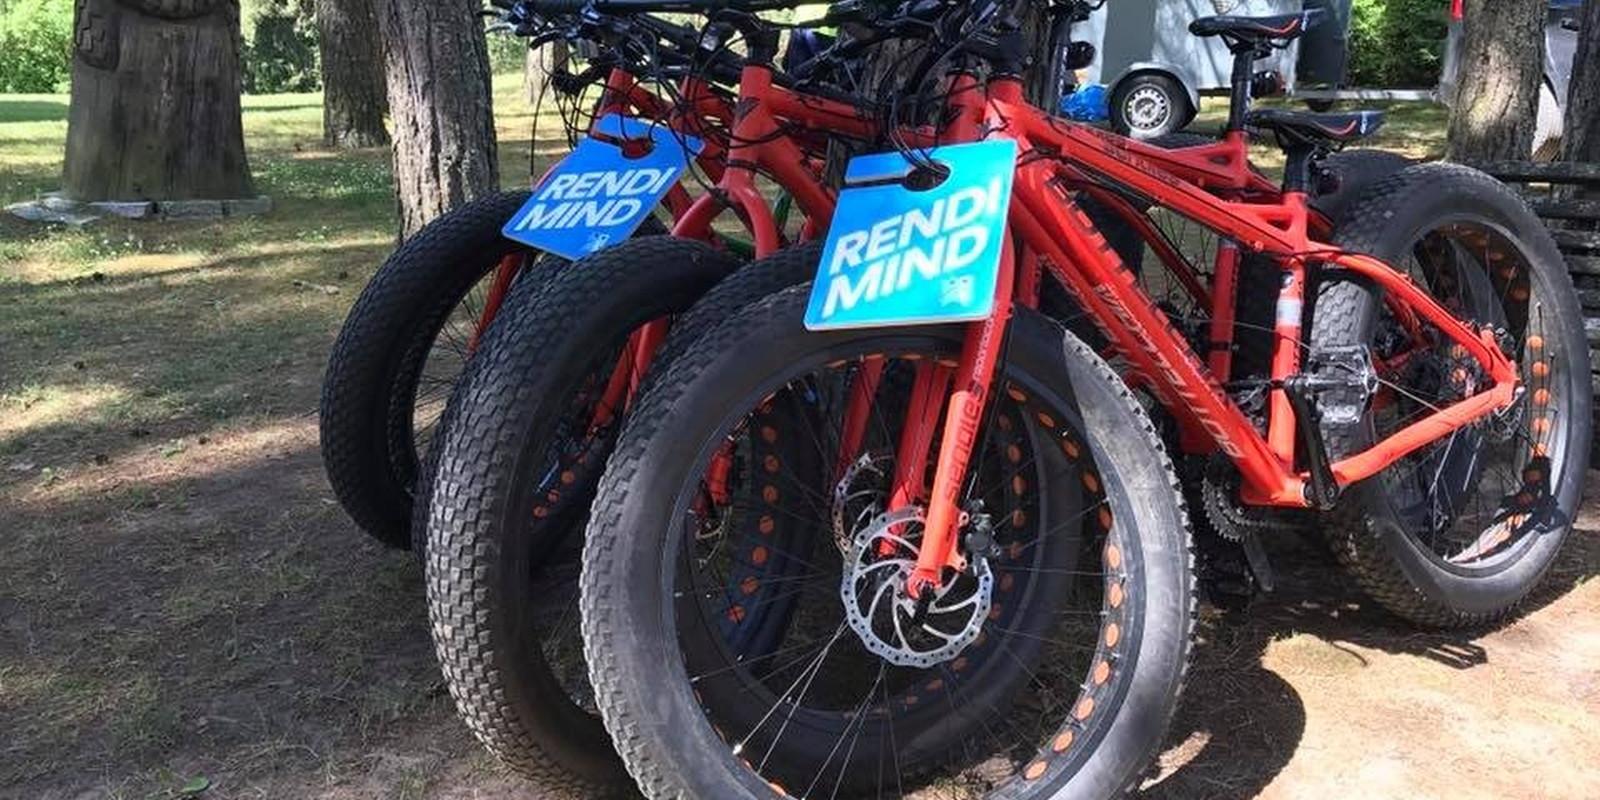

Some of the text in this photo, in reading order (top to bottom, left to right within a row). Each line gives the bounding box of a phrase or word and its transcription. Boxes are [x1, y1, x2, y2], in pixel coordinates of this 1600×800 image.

[514, 197, 642, 231] MIND
[537, 166, 677, 201] RENDI
[829, 176, 1001, 275] RENDI
[822, 226, 990, 319] MIND
